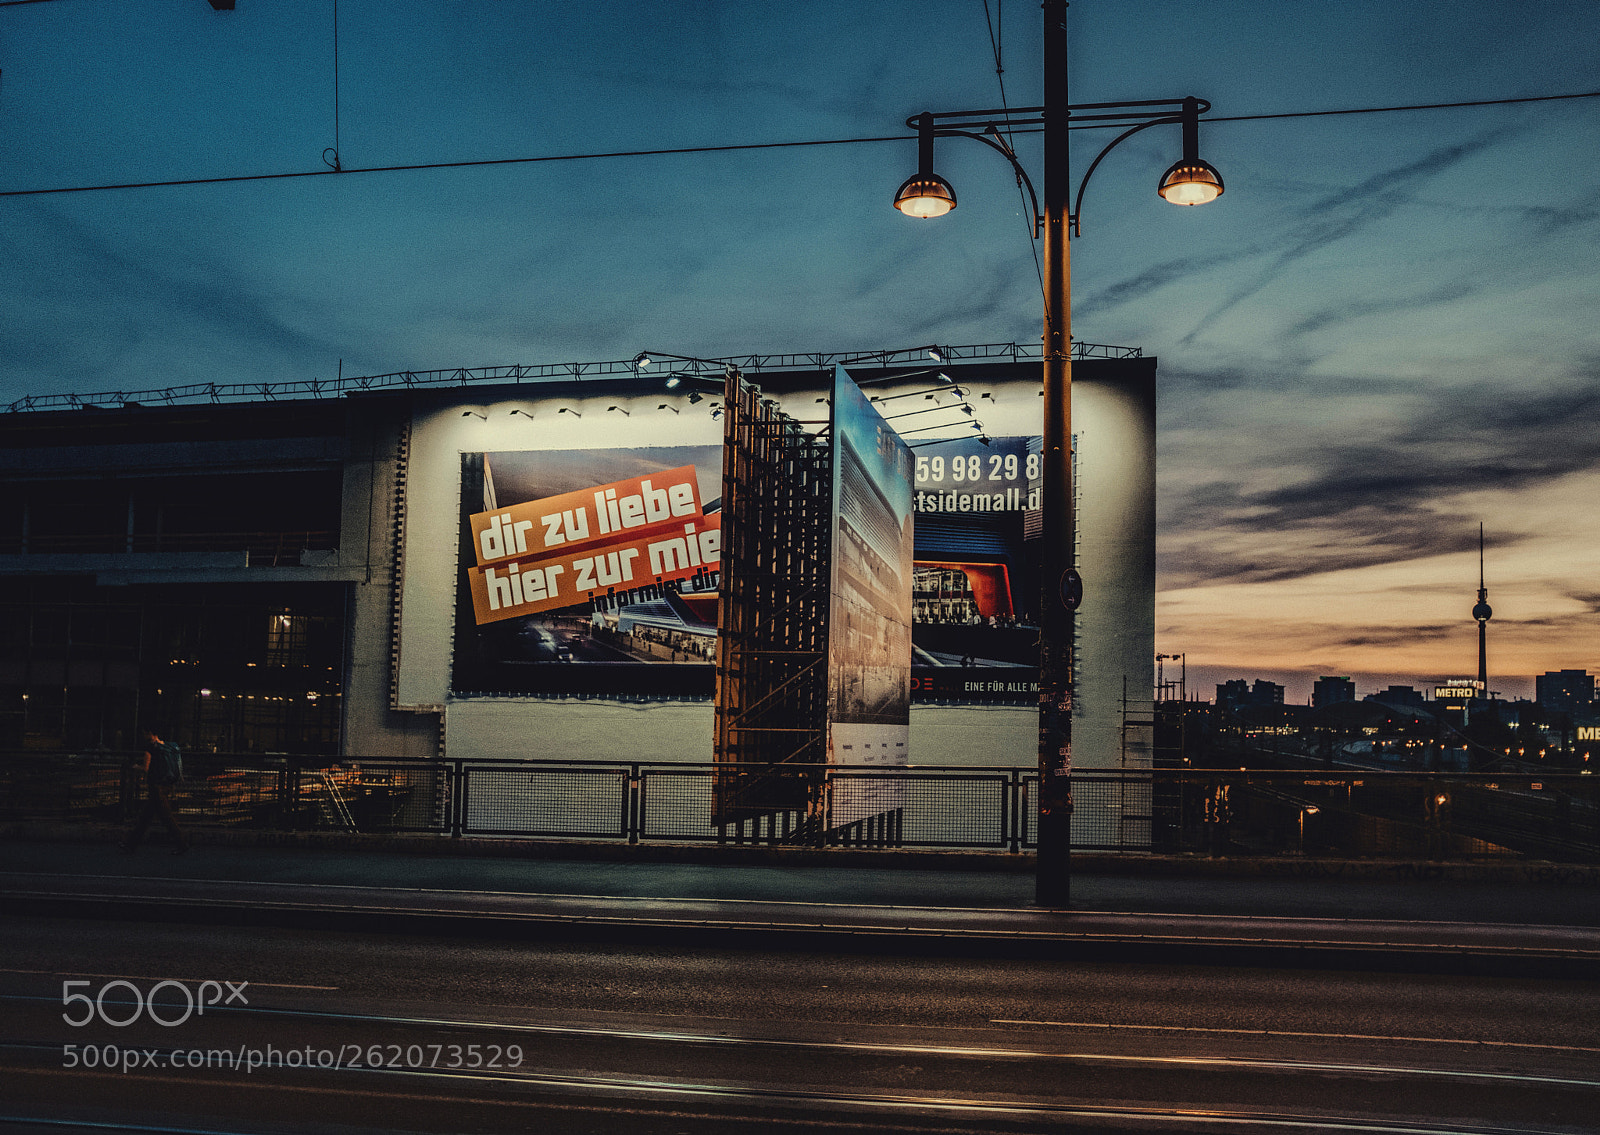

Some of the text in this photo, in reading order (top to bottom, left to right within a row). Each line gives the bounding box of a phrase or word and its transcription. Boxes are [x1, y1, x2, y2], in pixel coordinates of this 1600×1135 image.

[916, 456, 945, 482] 59
[952, 455, 981, 482] 98
[988, 454, 1018, 481] 29
[480, 479, 696, 560] dir zu liebe
[485, 563, 564, 611] hier
[573, 548, 639, 592] zur
[588, 576, 687, 613] informier
[964, 681, 985, 692] EINE
[987, 679, 1006, 692] FÜR
[1006, 681, 1027, 692] ALLE
[1436, 688, 1473, 698] METRO
